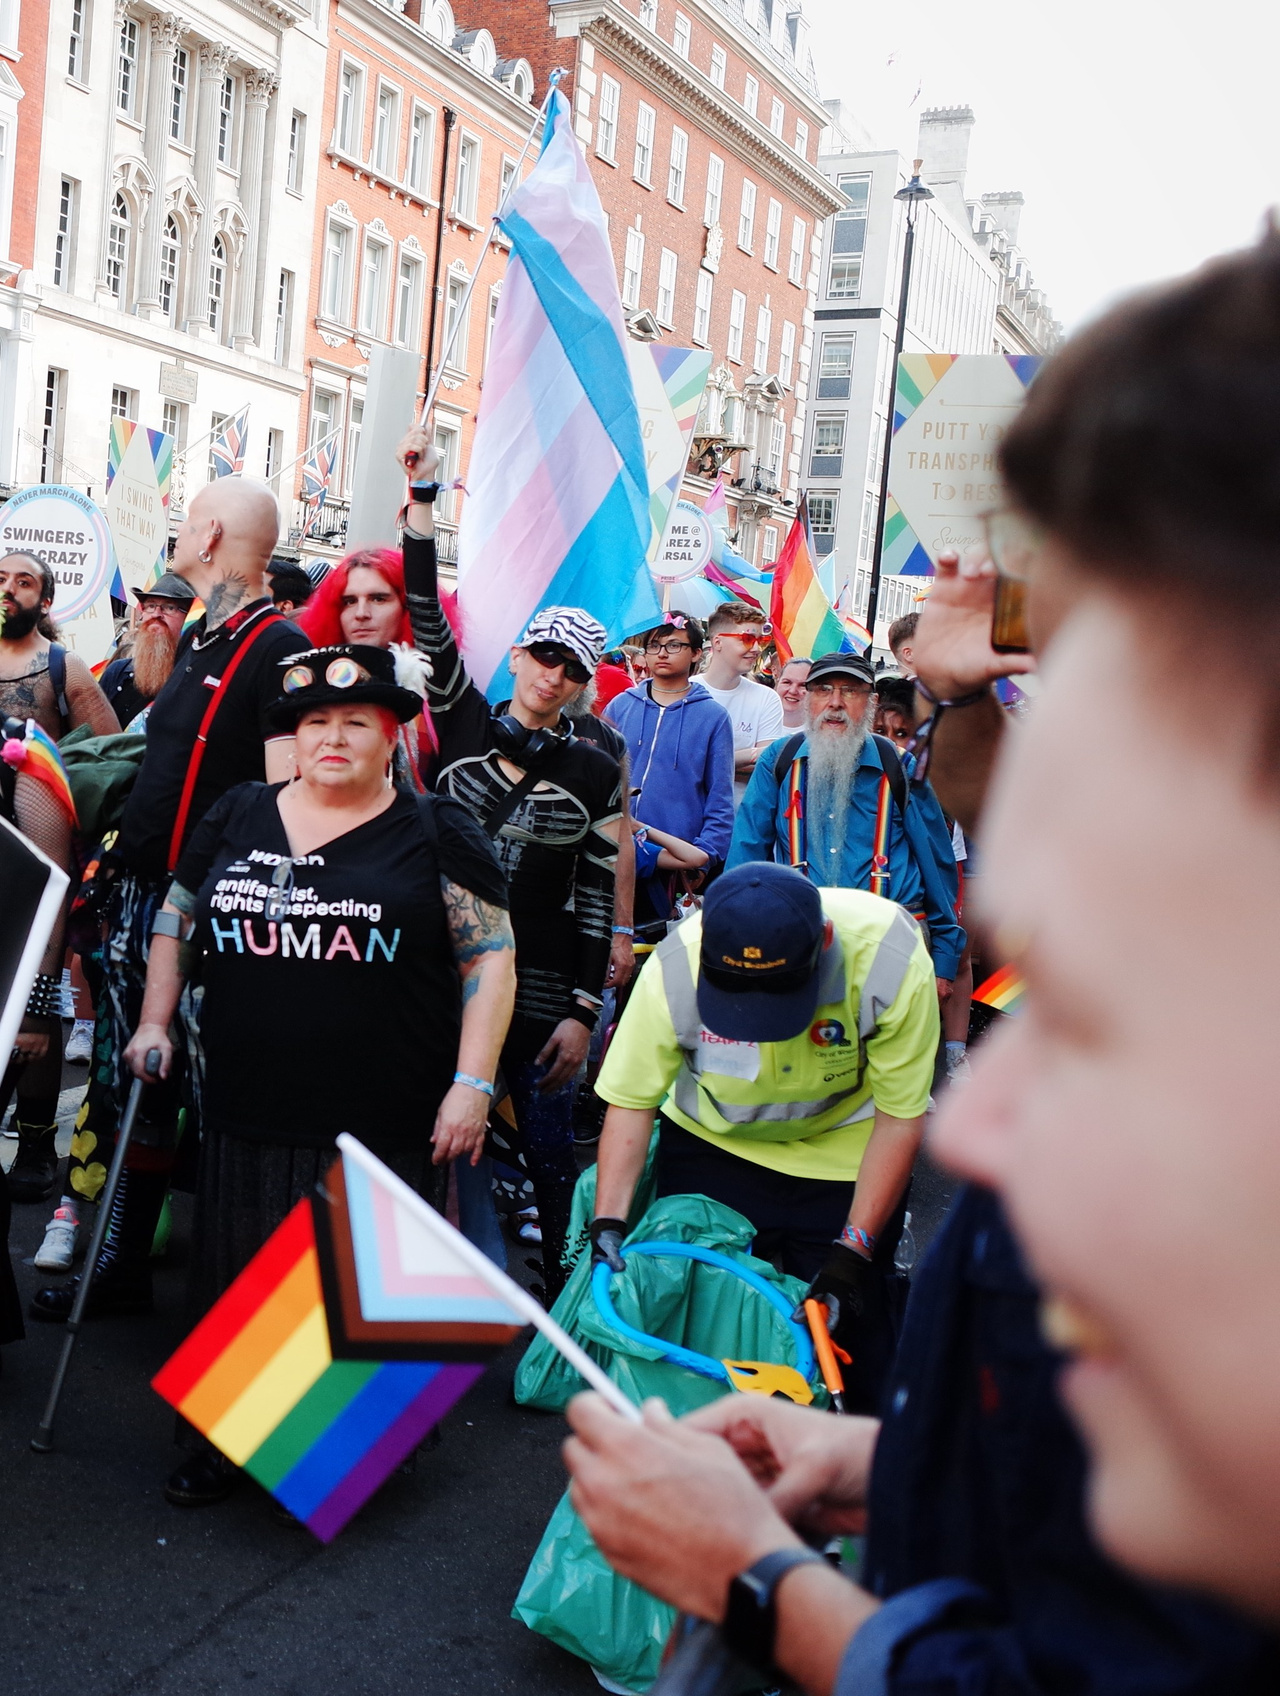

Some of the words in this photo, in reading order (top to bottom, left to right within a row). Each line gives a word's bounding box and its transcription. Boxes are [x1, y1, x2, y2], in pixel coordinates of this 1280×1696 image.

[922, 421, 969, 440] PUTT
[12, 490, 39, 508] NEVER
[39, 487, 69, 497] MARCH
[69, 492, 93, 513] ALONE
[127, 486, 153, 513] SWING
[932, 482, 956, 500] TO
[963, 483, 1000, 501] RES
[685, 505, 701, 516] ALONE
[116, 507, 135, 531] THAT
[139, 517, 156, 540] WAY
[691, 525, 701, 536] @
[3, 527, 85, 545] SWINGERS
[693, 539, 702, 548] &
[37, 549, 88, 566] CRAZY
[54, 572, 84, 586] LUB
[210, 891, 265, 913] rights
[270, 898, 382, 922] respecting
[210, 917, 401, 962] HUMAN
